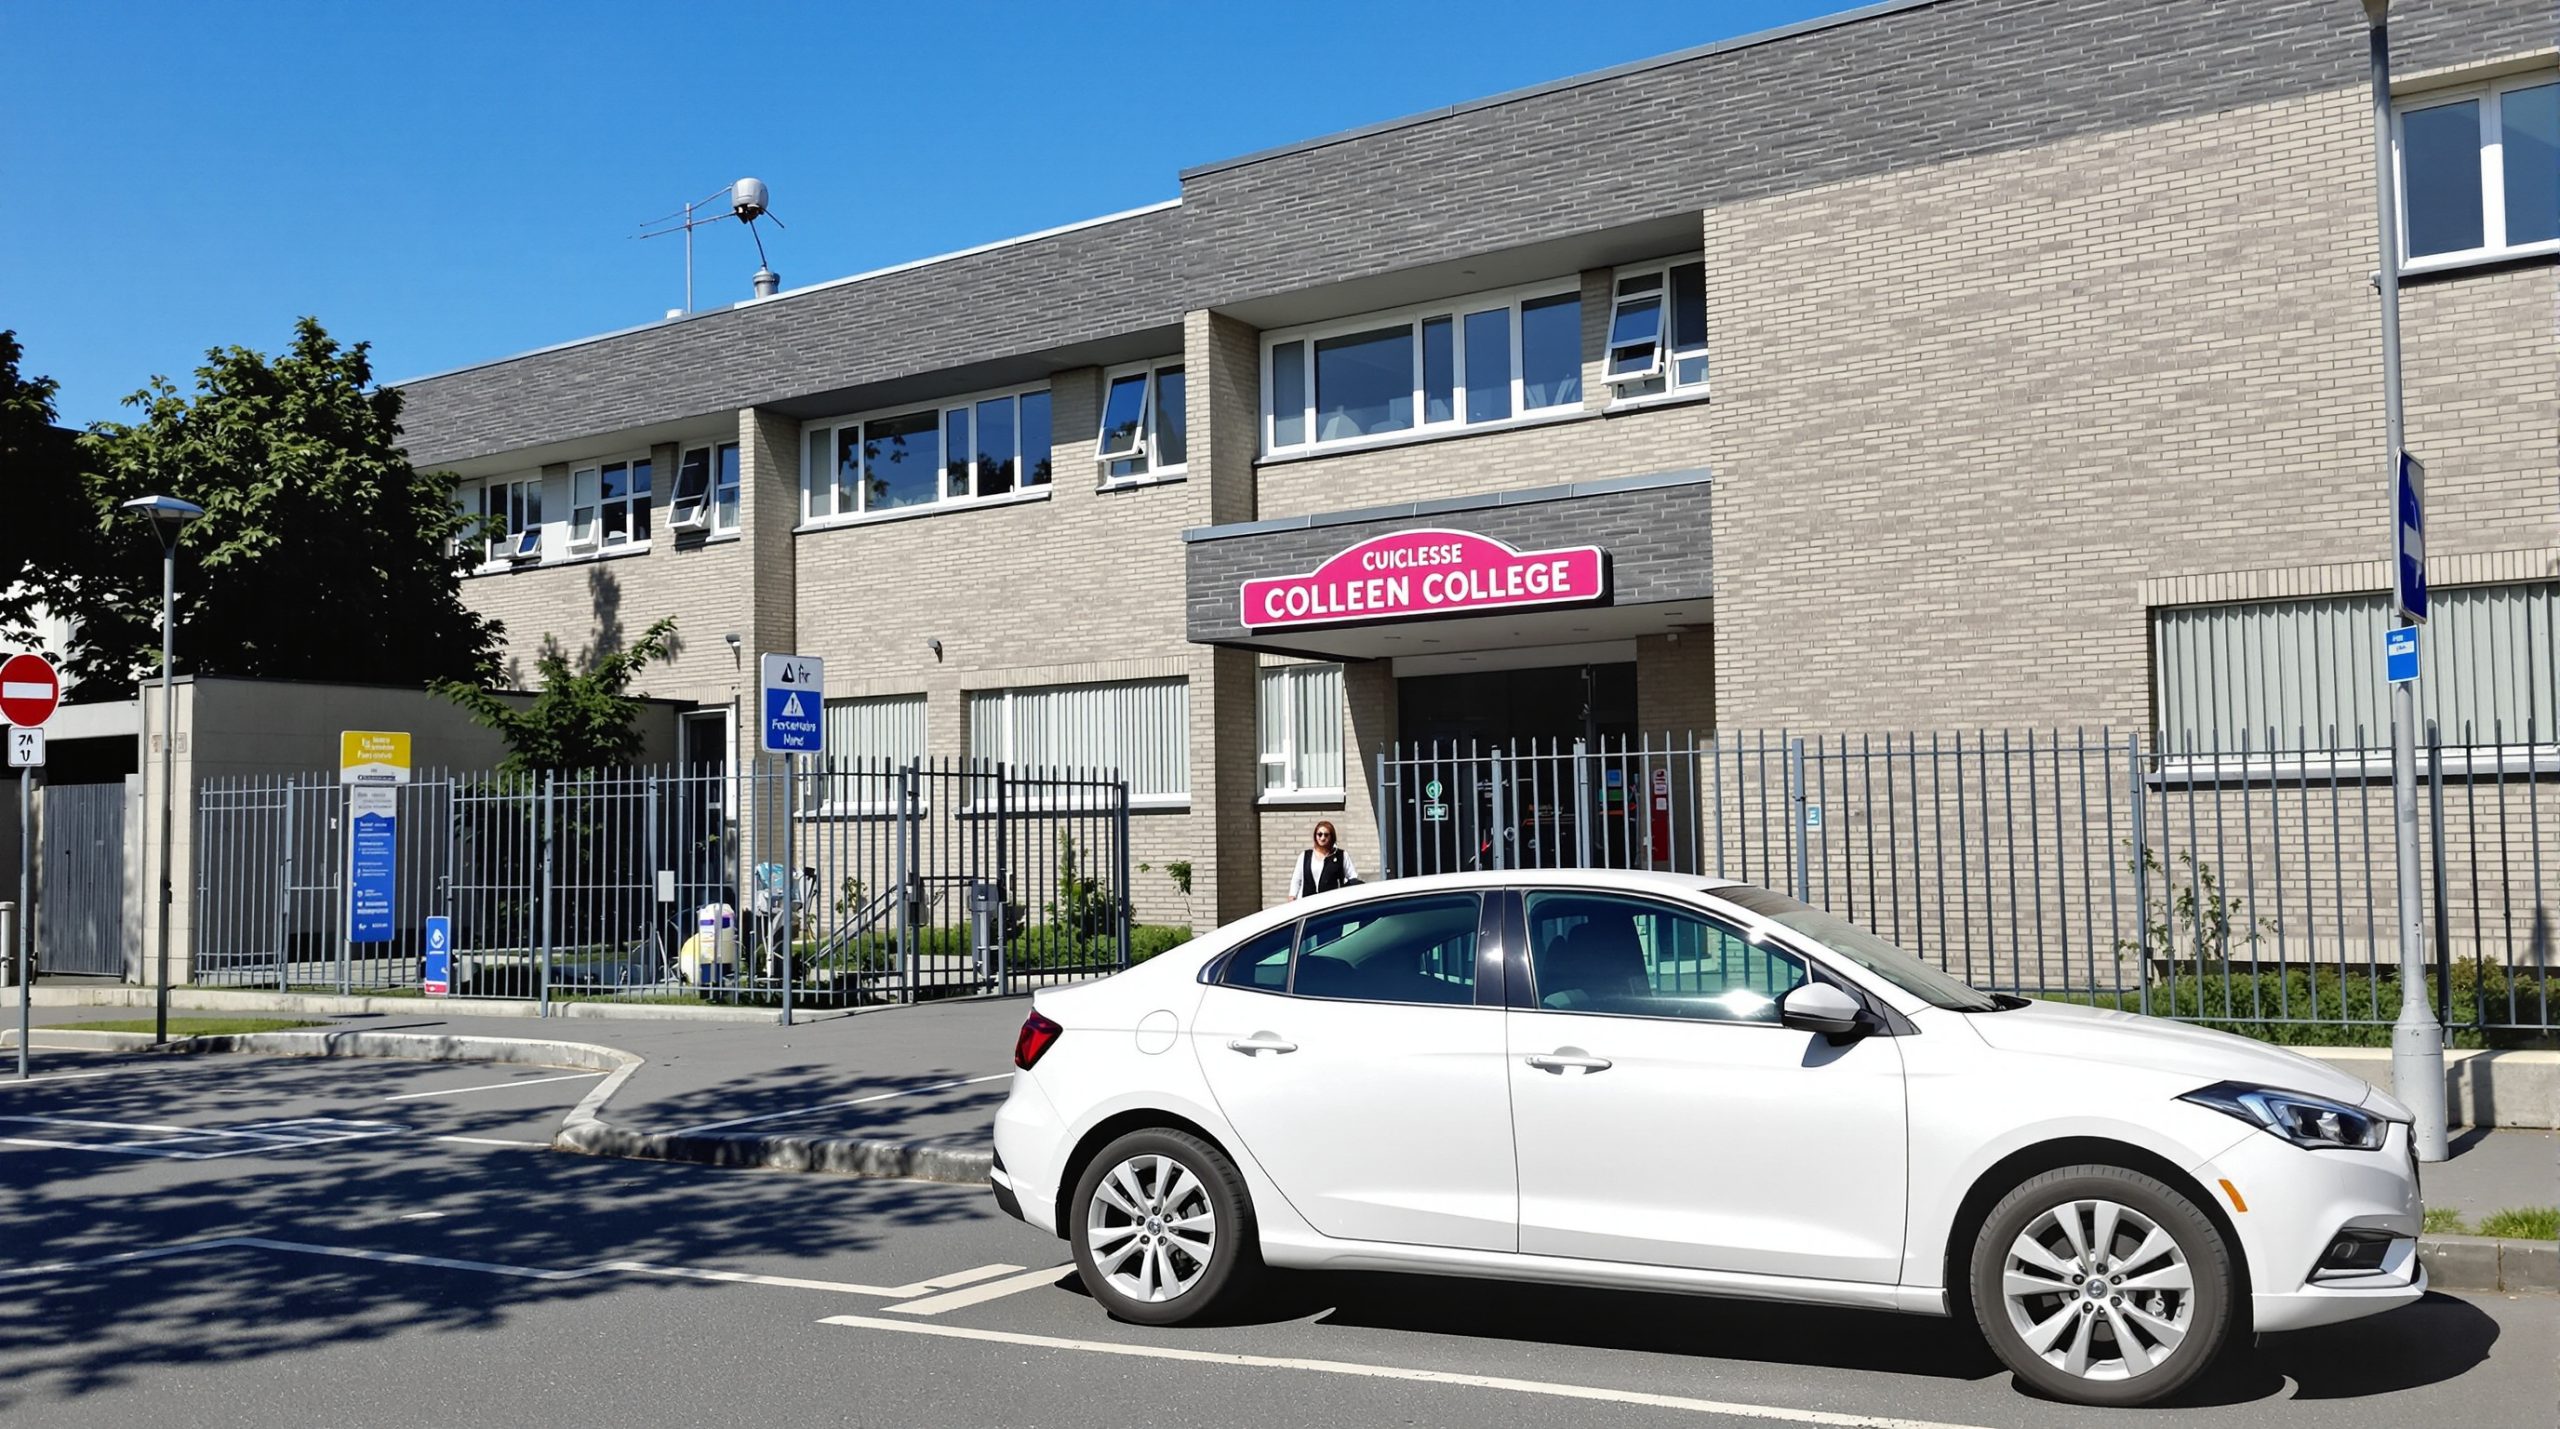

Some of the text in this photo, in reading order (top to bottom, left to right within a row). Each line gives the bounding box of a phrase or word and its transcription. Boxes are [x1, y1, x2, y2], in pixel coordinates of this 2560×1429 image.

[1362, 543, 1463, 572] CUICLESSE
[1264, 560, 1571, 619] COLLEEN COLLEGE
